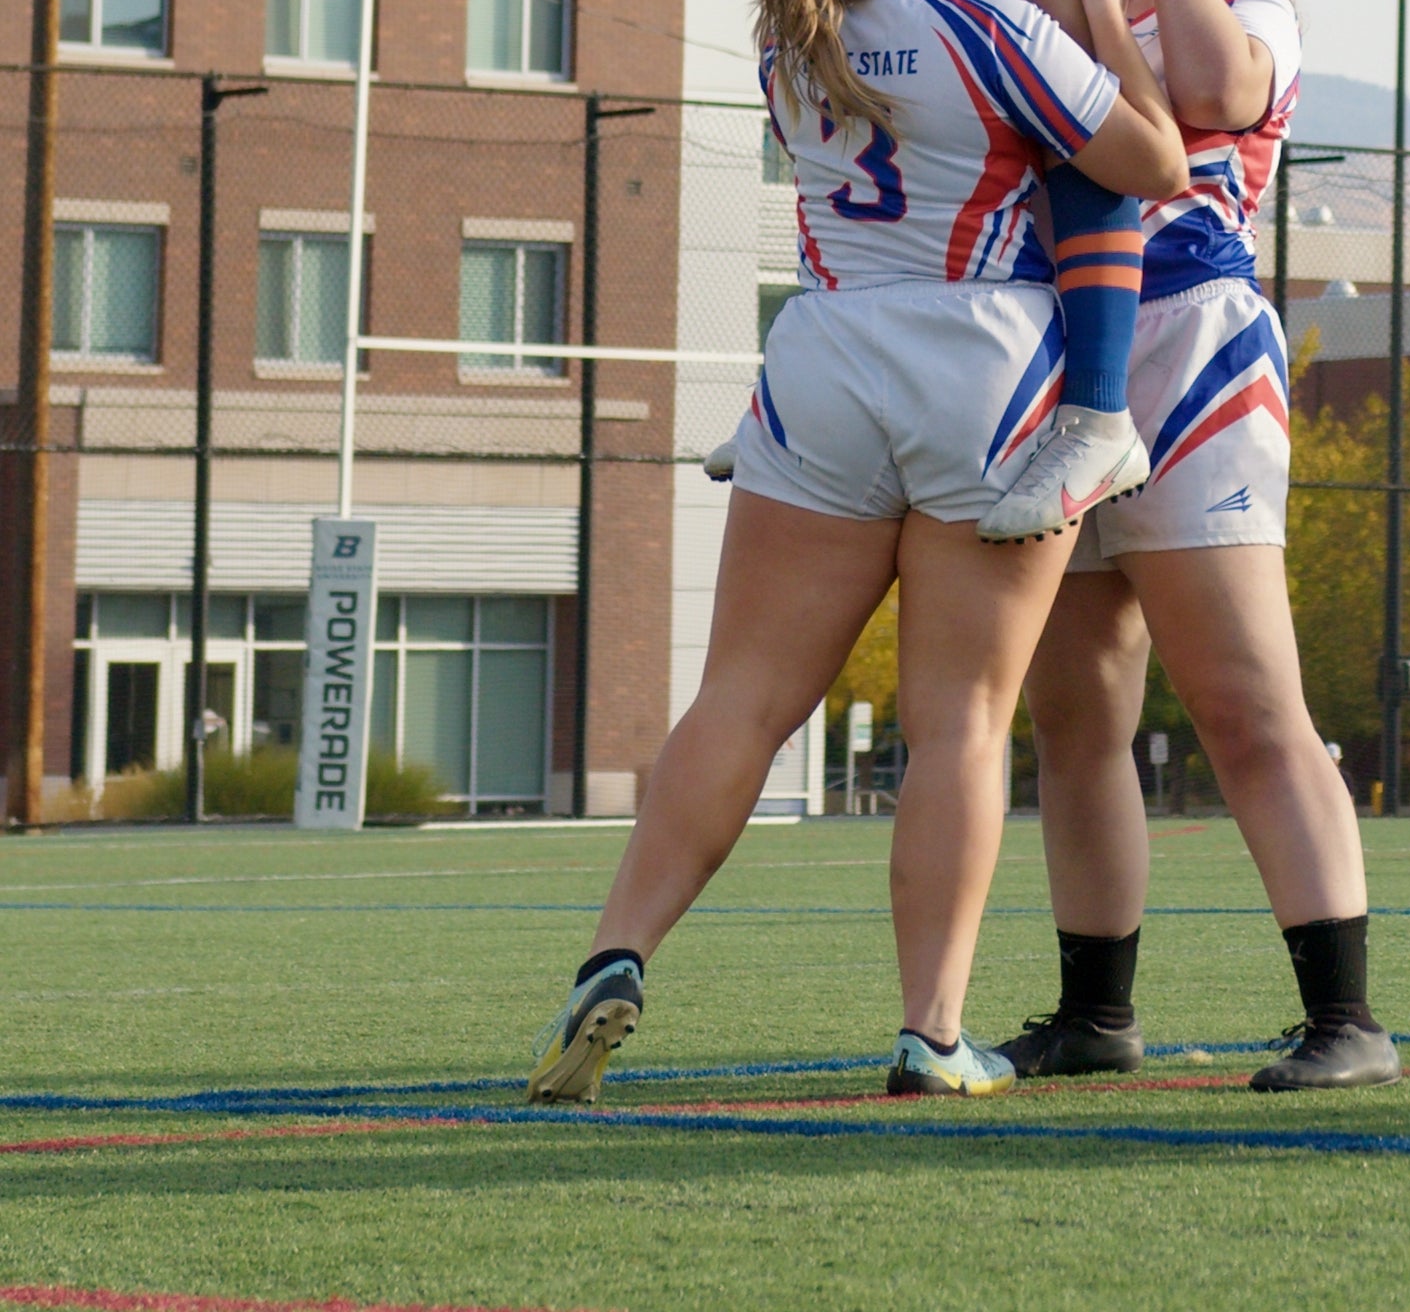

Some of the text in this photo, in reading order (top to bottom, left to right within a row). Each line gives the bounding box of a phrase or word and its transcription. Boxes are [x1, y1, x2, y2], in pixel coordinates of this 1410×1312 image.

[857, 49, 919, 76] STATE
[819, 96, 908, 223] 3
[333, 535, 361, 559] B
[315, 591, 358, 811] POWERADE
